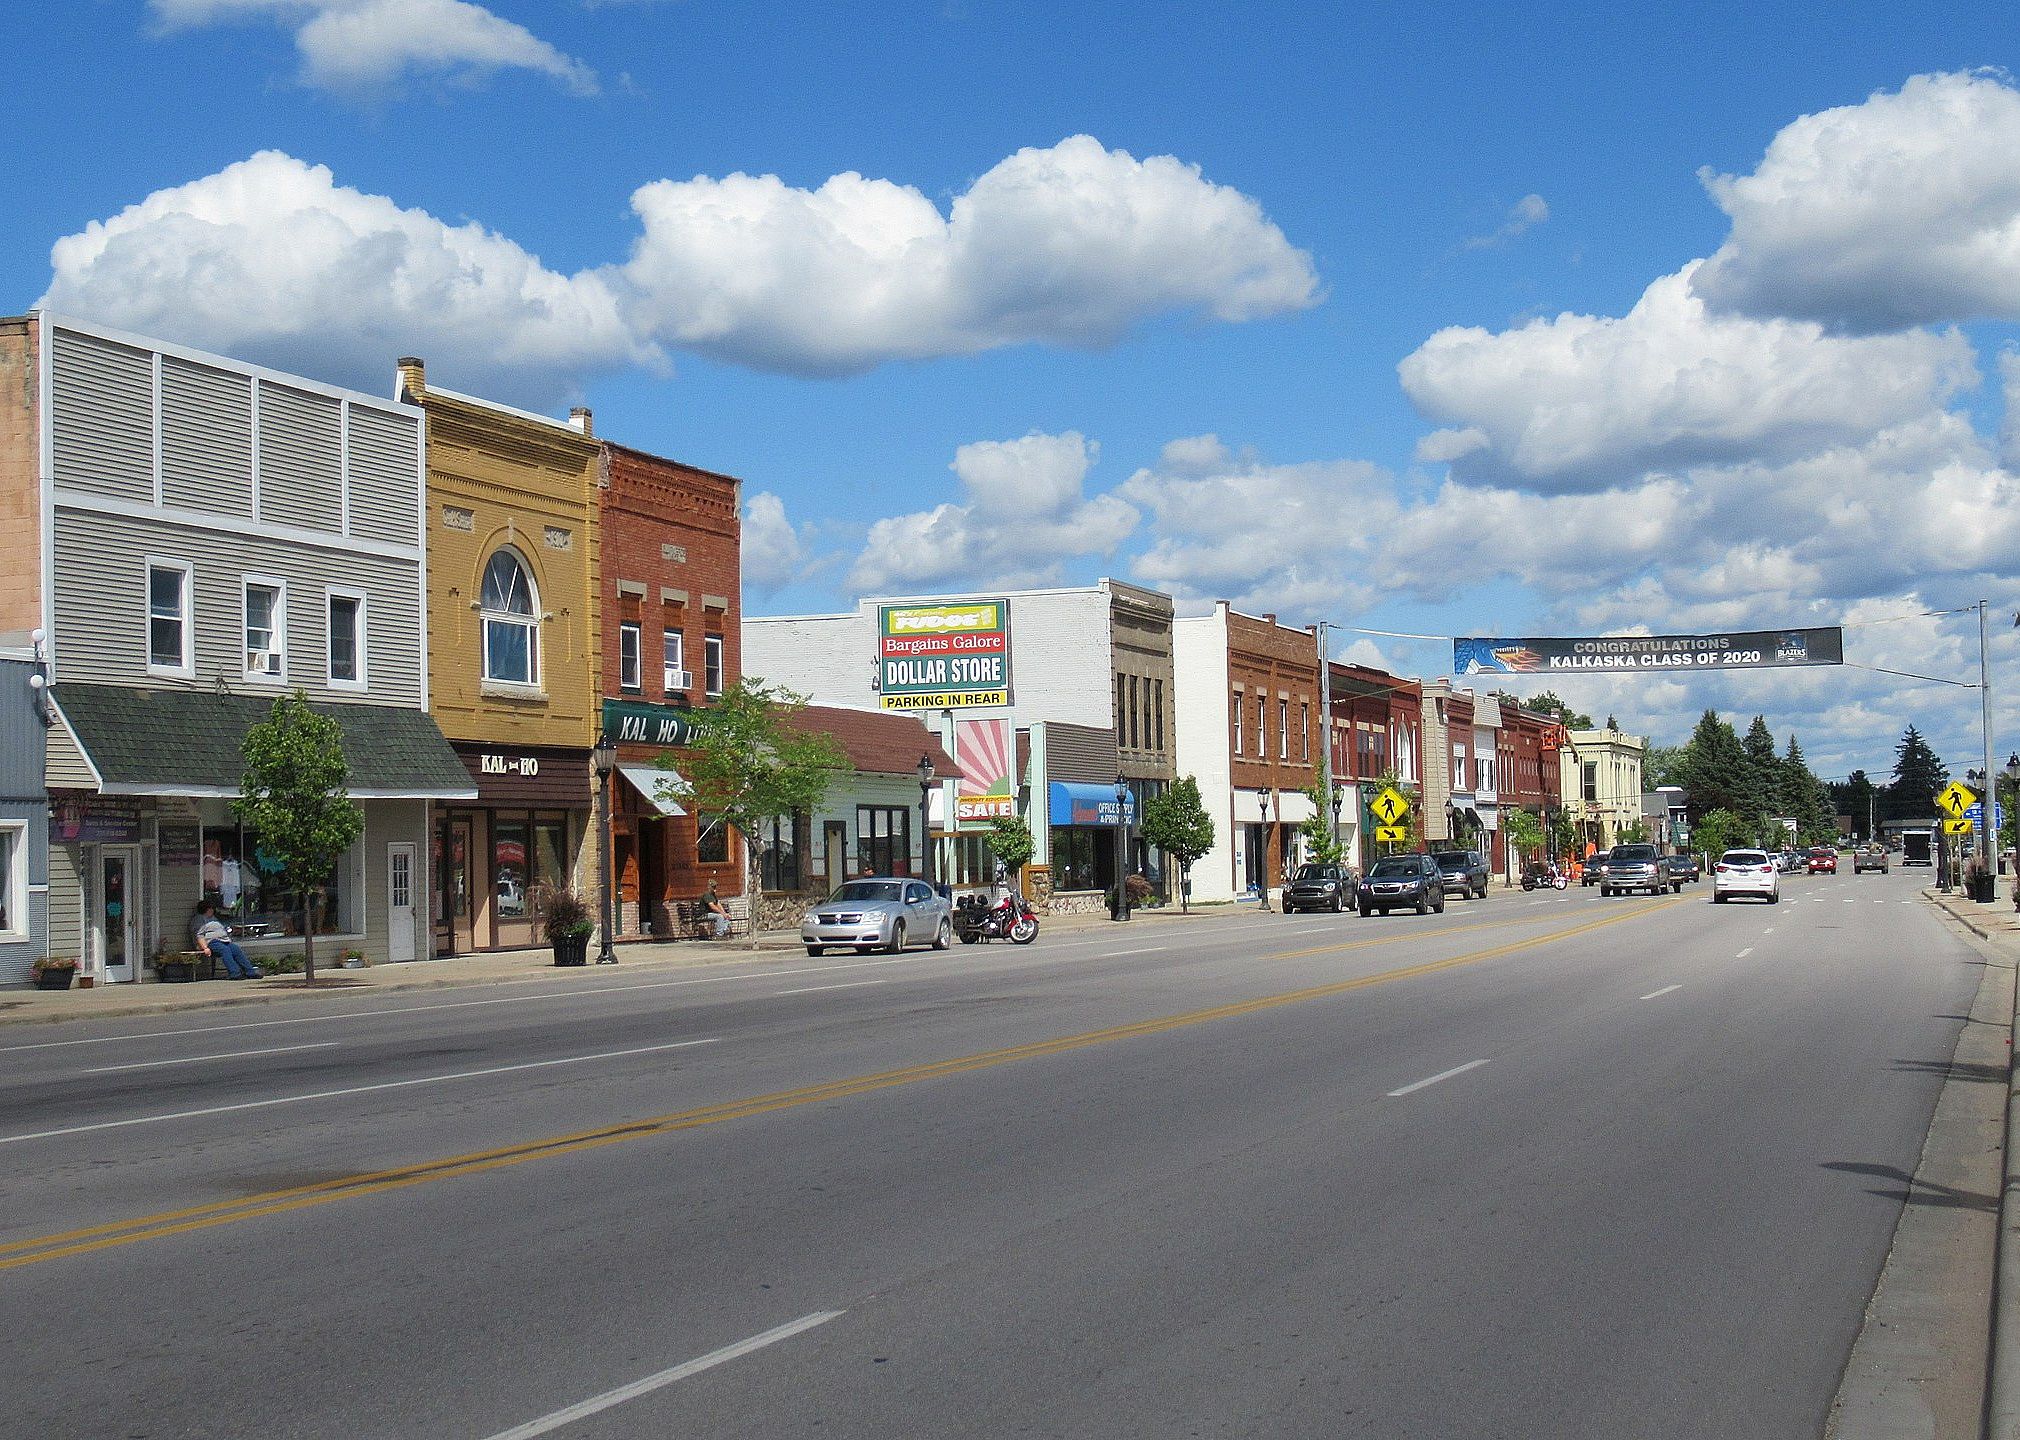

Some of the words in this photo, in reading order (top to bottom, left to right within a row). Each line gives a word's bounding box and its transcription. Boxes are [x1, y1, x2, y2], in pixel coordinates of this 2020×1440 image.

[886, 638, 949, 654] Bargains
[952, 635, 1001, 649] Galore
[1573, 638, 1730, 654] CONGRATULATIONS
[1777, 648, 1806, 657] BLAZERS
[1550, 655, 1637, 668] KALKASKA
[1640, 653, 1692, 667] CLASS
[1696, 652, 1718, 665] OF
[1722, 650, 1761, 664] 2020
[887, 660, 946, 685] DOLLAR
[951, 657, 1001, 682] STORE
[887, 695, 944, 708] PARKING
[948, 694, 961, 706] IN
[965, 693, 1000, 705] REAR
[620, 716, 647, 741] KAL
[657, 719, 679, 742] HO
[480, 754, 539, 776] KAL-HO
[959, 803, 1011, 817] SALE
[1098, 802, 1115, 814] OFFICE
